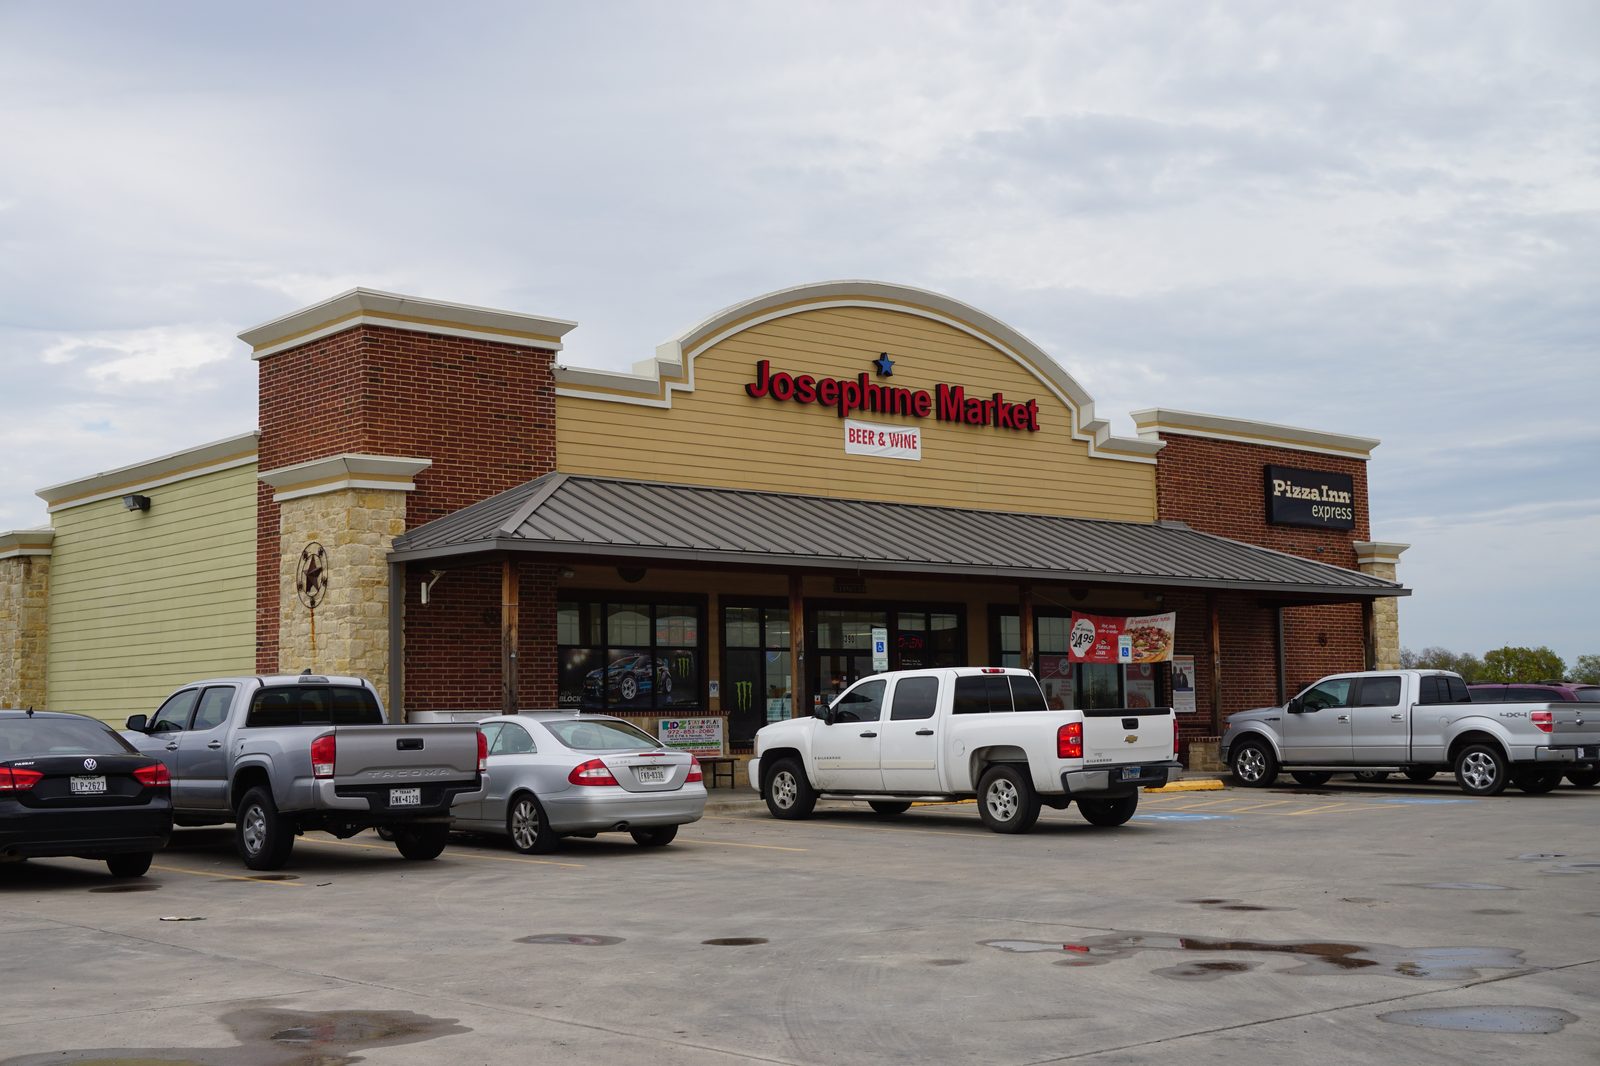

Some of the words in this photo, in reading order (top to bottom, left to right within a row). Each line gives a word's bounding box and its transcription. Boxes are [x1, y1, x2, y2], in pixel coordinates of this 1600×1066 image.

[745, 360, 931, 418] Josephine
[935, 383, 1040, 432] Market
[848, 427, 875, 446] BEER
[878, 431, 887, 447] &
[888, 432, 918, 450] WINE
[1312, 504, 1353, 522] express
[559, 695, 582, 703] BLOCK
[662, 720, 687, 731] KIDZ
[367, 767, 450, 779] TACOMA
